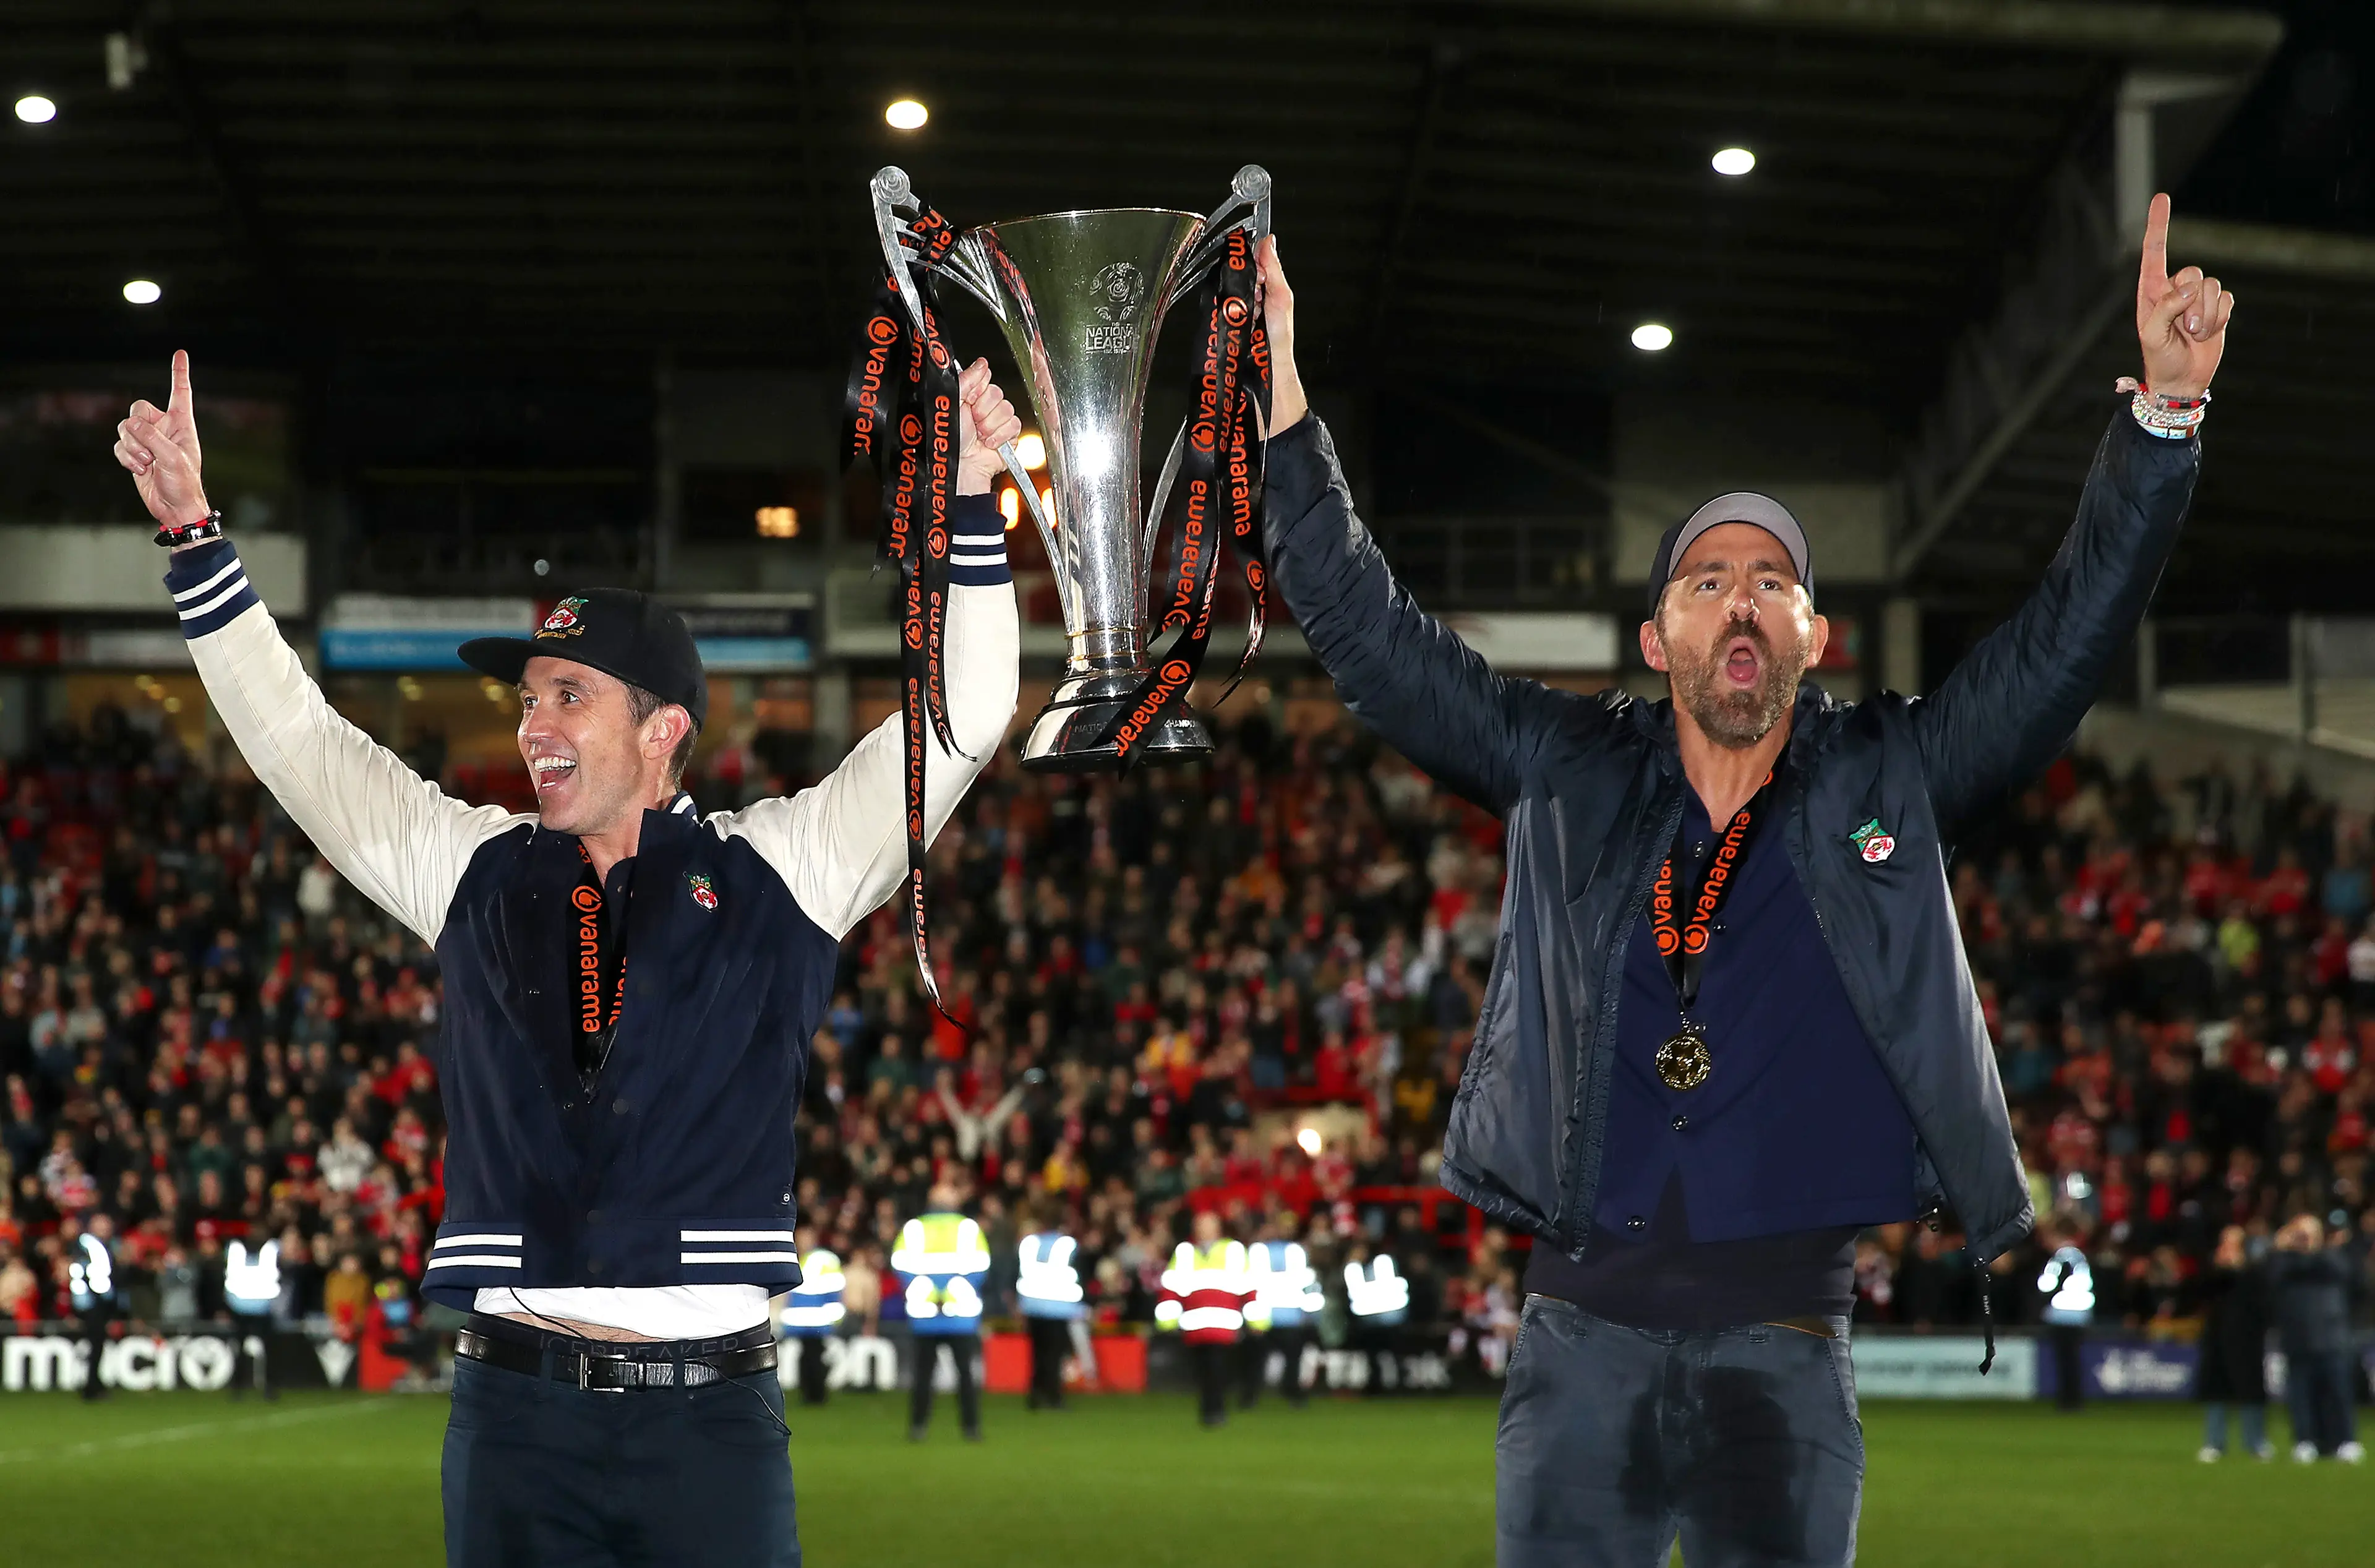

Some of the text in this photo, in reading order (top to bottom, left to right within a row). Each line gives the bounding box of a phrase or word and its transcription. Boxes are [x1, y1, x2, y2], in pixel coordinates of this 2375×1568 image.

[1085, 336, 1132, 351] LEAGU
[1219, 329, 1241, 453] vanarama
[932, 395, 950, 524] vanarama
[1173, 479, 1207, 607] vanarama
[928, 591, 941, 719] vanarama
[909, 677, 921, 807] vanarama
[1692, 812, 1751, 922] vanarama
[580, 914, 600, 1032] vanarama
